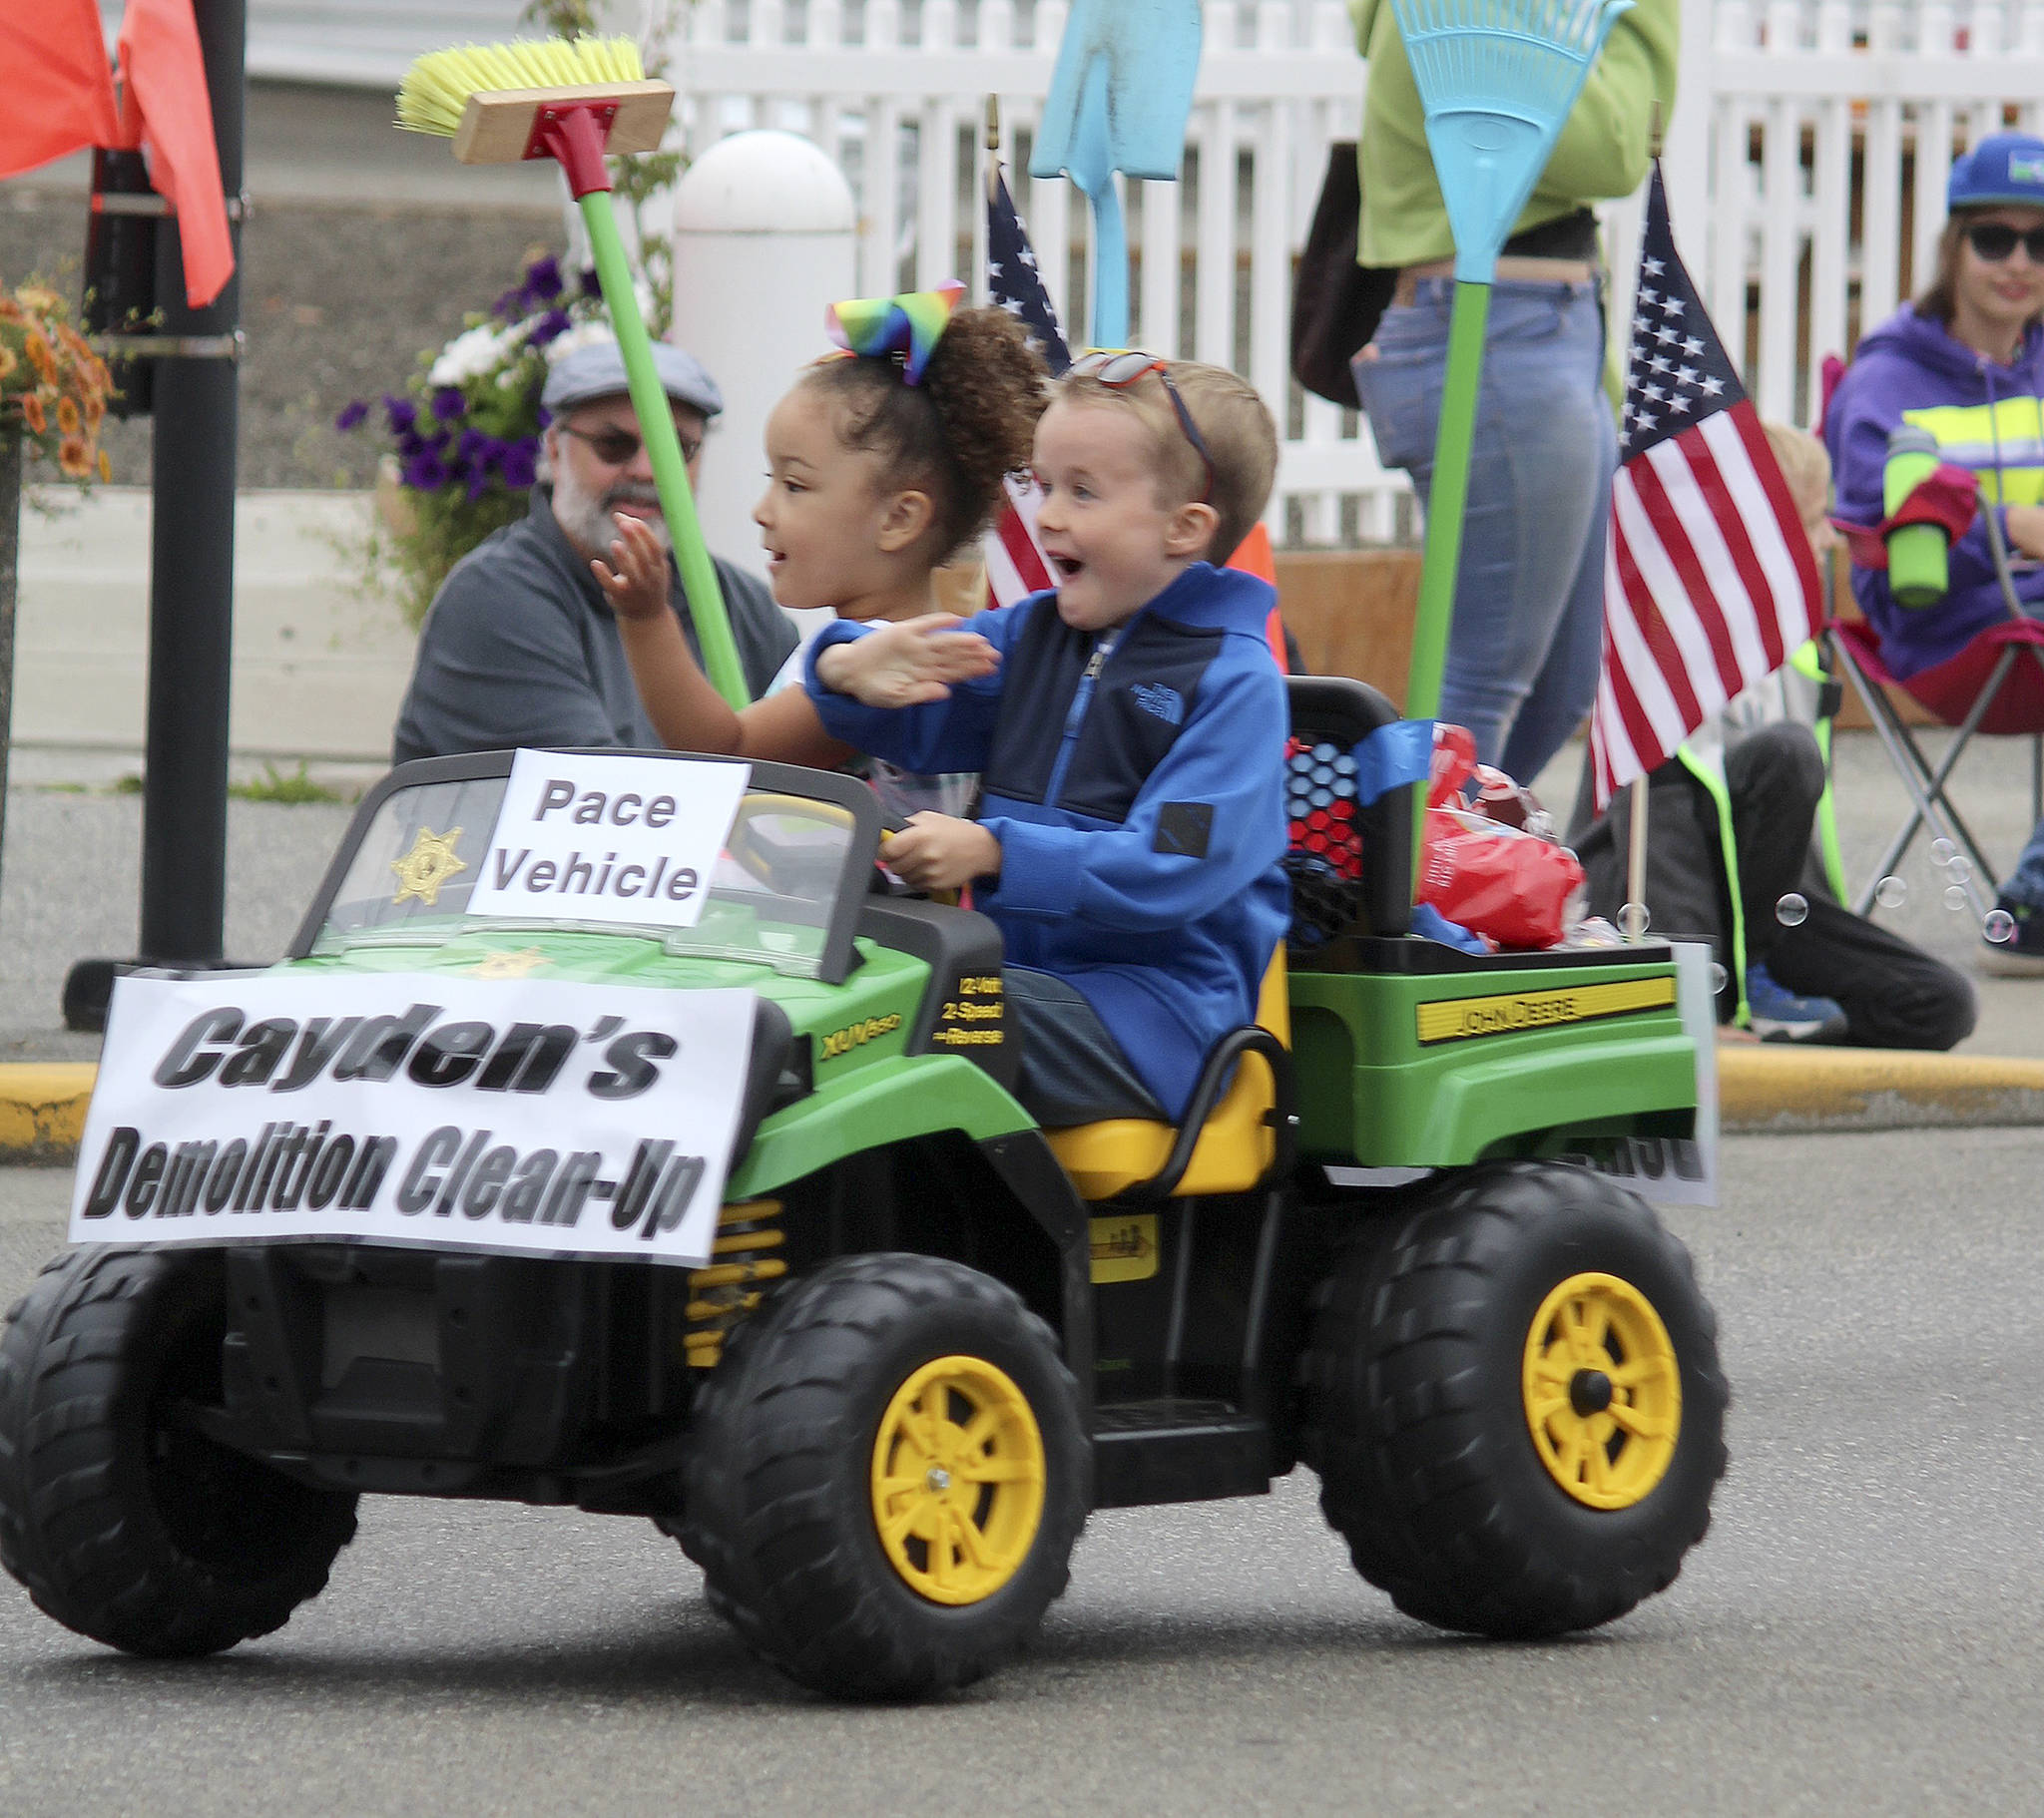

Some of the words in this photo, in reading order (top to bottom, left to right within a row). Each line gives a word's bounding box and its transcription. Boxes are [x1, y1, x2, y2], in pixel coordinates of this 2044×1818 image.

[531, 779, 678, 828] Pace
[492, 847, 700, 901] Vehicle
[1456, 1006, 1510, 1034] JOHN
[1513, 997, 1578, 1025] DEERE
[153, 1002, 679, 1101] Cayden's
[83, 1120, 398, 1223] Demolition
[396, 1124, 708, 1241] Clean-Up
